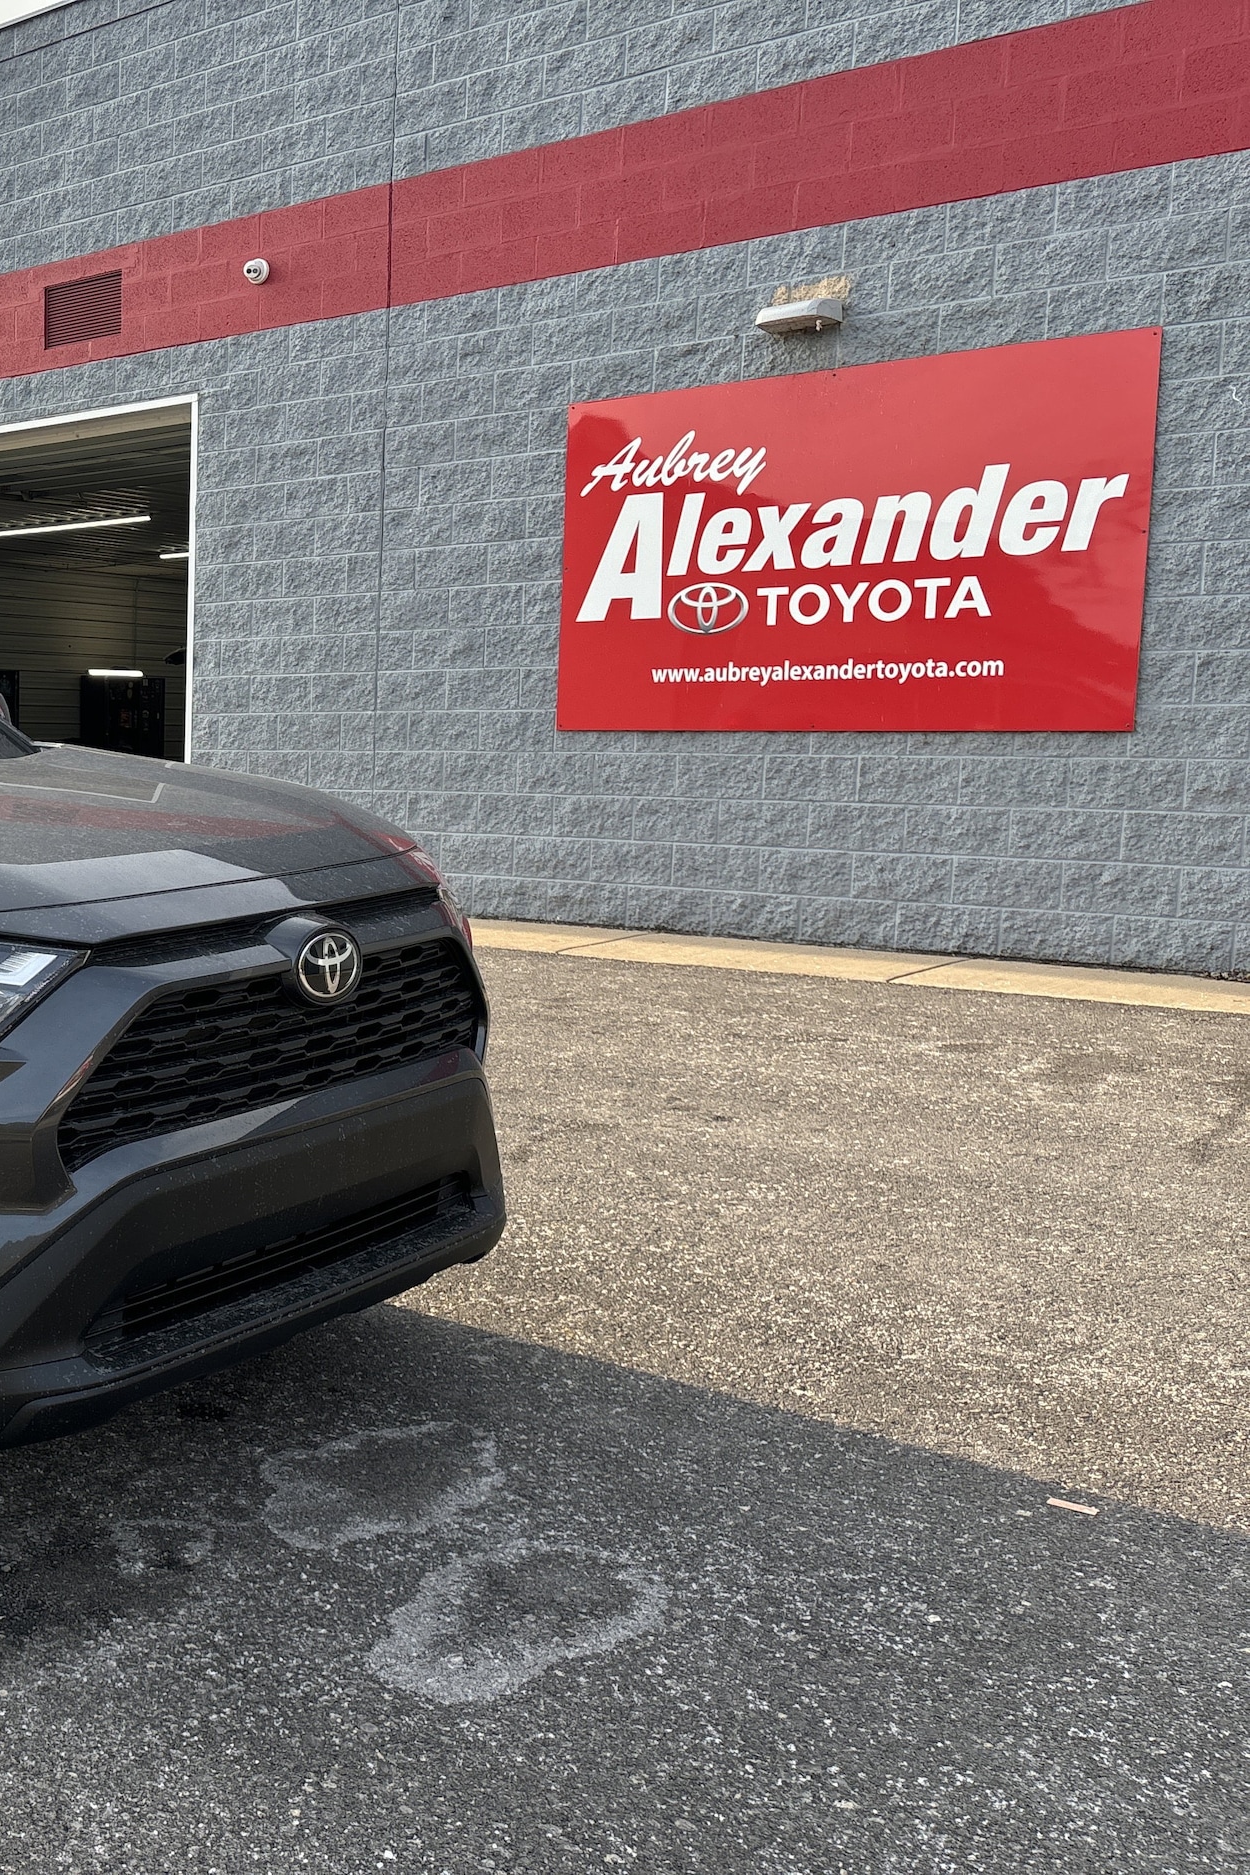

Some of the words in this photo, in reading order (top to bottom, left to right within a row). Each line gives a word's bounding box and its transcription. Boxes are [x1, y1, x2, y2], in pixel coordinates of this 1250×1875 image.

[580, 430, 767, 497] Aubrey
[575, 463, 1130, 623] Alexander
[756, 575, 992, 626] TOYOTA
[651, 659, 1004, 687] www.aubreyalexandertoyota.com
